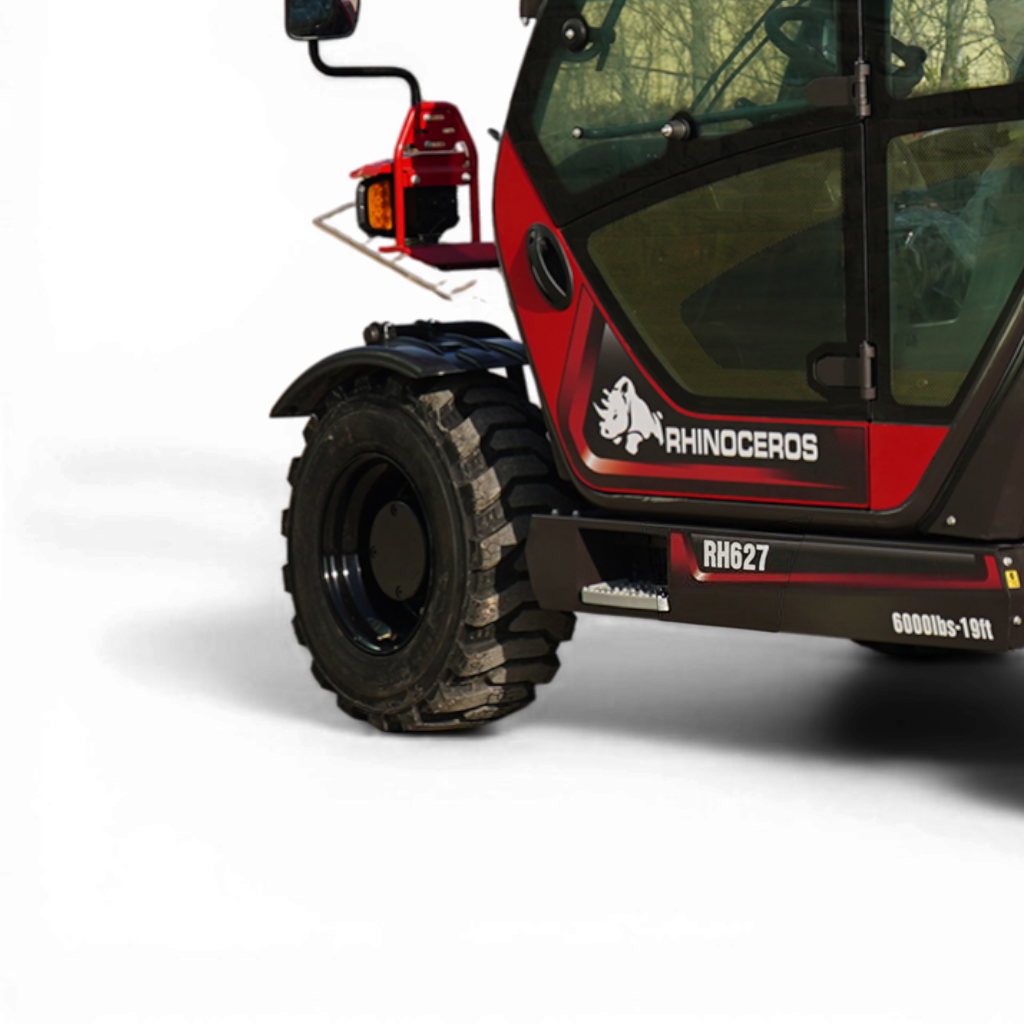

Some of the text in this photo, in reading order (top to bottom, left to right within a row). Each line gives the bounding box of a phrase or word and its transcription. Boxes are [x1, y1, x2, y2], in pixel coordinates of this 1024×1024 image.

[665, 426, 819, 462] RHINOCEROS
[703, 539, 770, 571] RH627
[892, 611, 994, 641] 6000lbs-19ft
